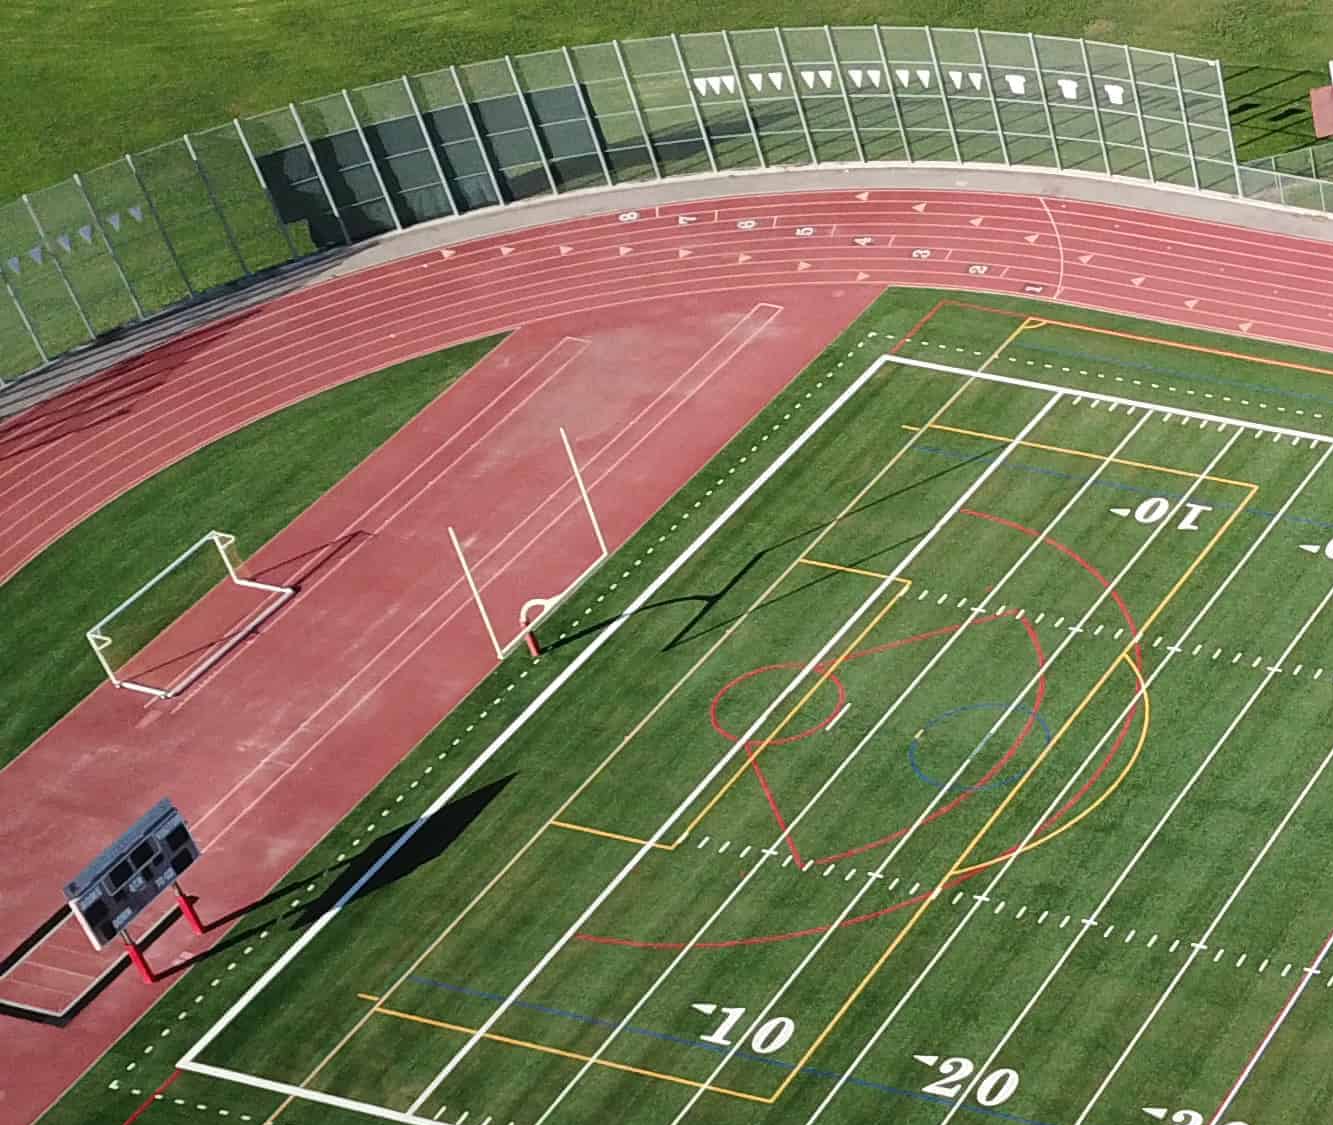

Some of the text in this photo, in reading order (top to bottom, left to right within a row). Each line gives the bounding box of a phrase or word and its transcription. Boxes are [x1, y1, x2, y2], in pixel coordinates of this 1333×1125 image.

[619, 211, 638, 222] 8
[678, 215, 697, 225] 7
[737, 219, 756, 230] 6
[795, 226, 814, 236] 5
[854, 236, 873, 246] 4
[912, 248, 931, 259] 3
[968, 264, 988, 275] 2
[1024, 285, 1043, 294] 1
[1133, 497, 1214, 531] 10
[700, 1006, 795, 1054] 10
[921, 1057, 1019, 1107] 20
